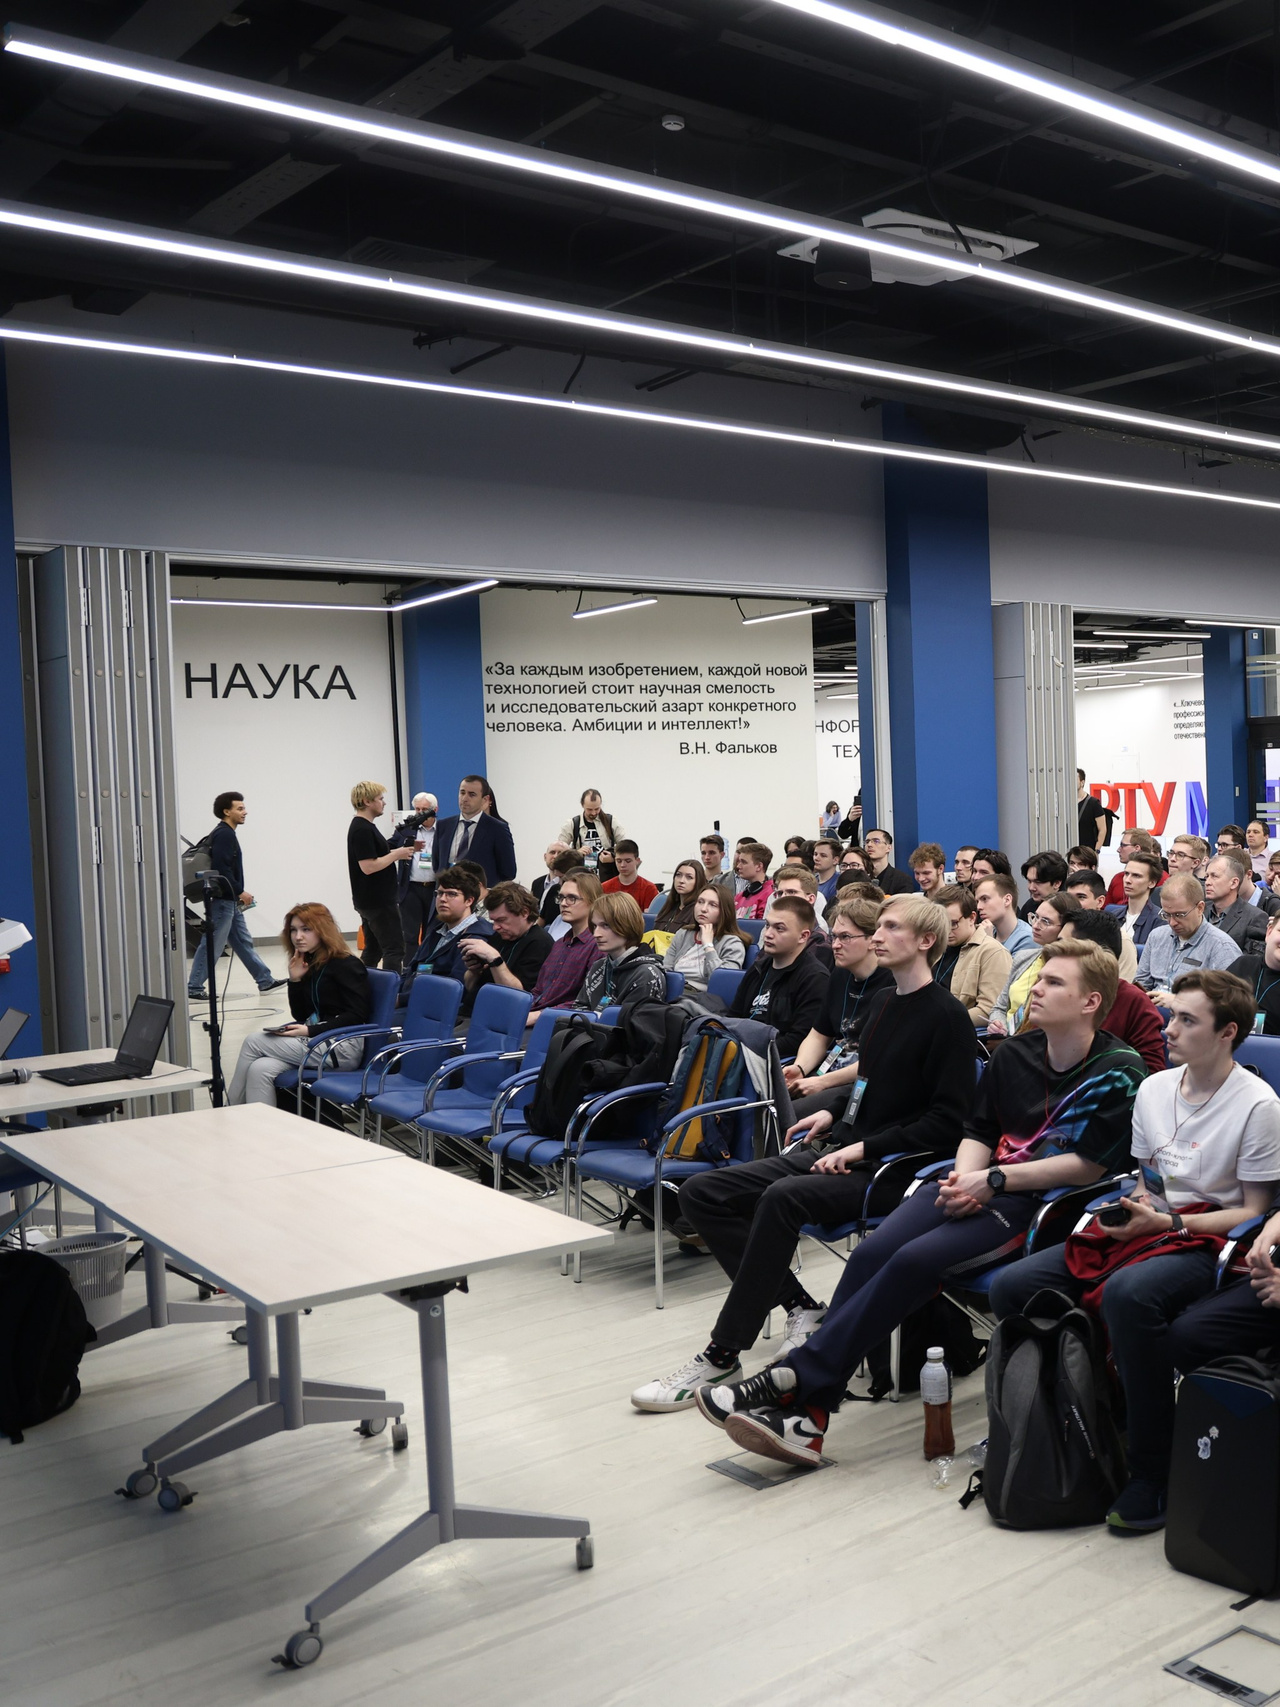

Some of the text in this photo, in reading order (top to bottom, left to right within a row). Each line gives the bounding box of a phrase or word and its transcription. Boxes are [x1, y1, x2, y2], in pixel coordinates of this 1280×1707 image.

[485, 662, 808, 679] «За каждым изобретением, каждой новой
[184, 662, 357, 700] НАУКА
[485, 681, 775, 697] технологией стоит научная смелость
[486, 700, 796, 715] и исследовательский азарт конкретного
[486, 717, 750, 734] человека. Амбиции и интеллект!»
[679, 740, 778, 755] В.Н. Фальков
[1089, 781, 1177, 837] РТУ
